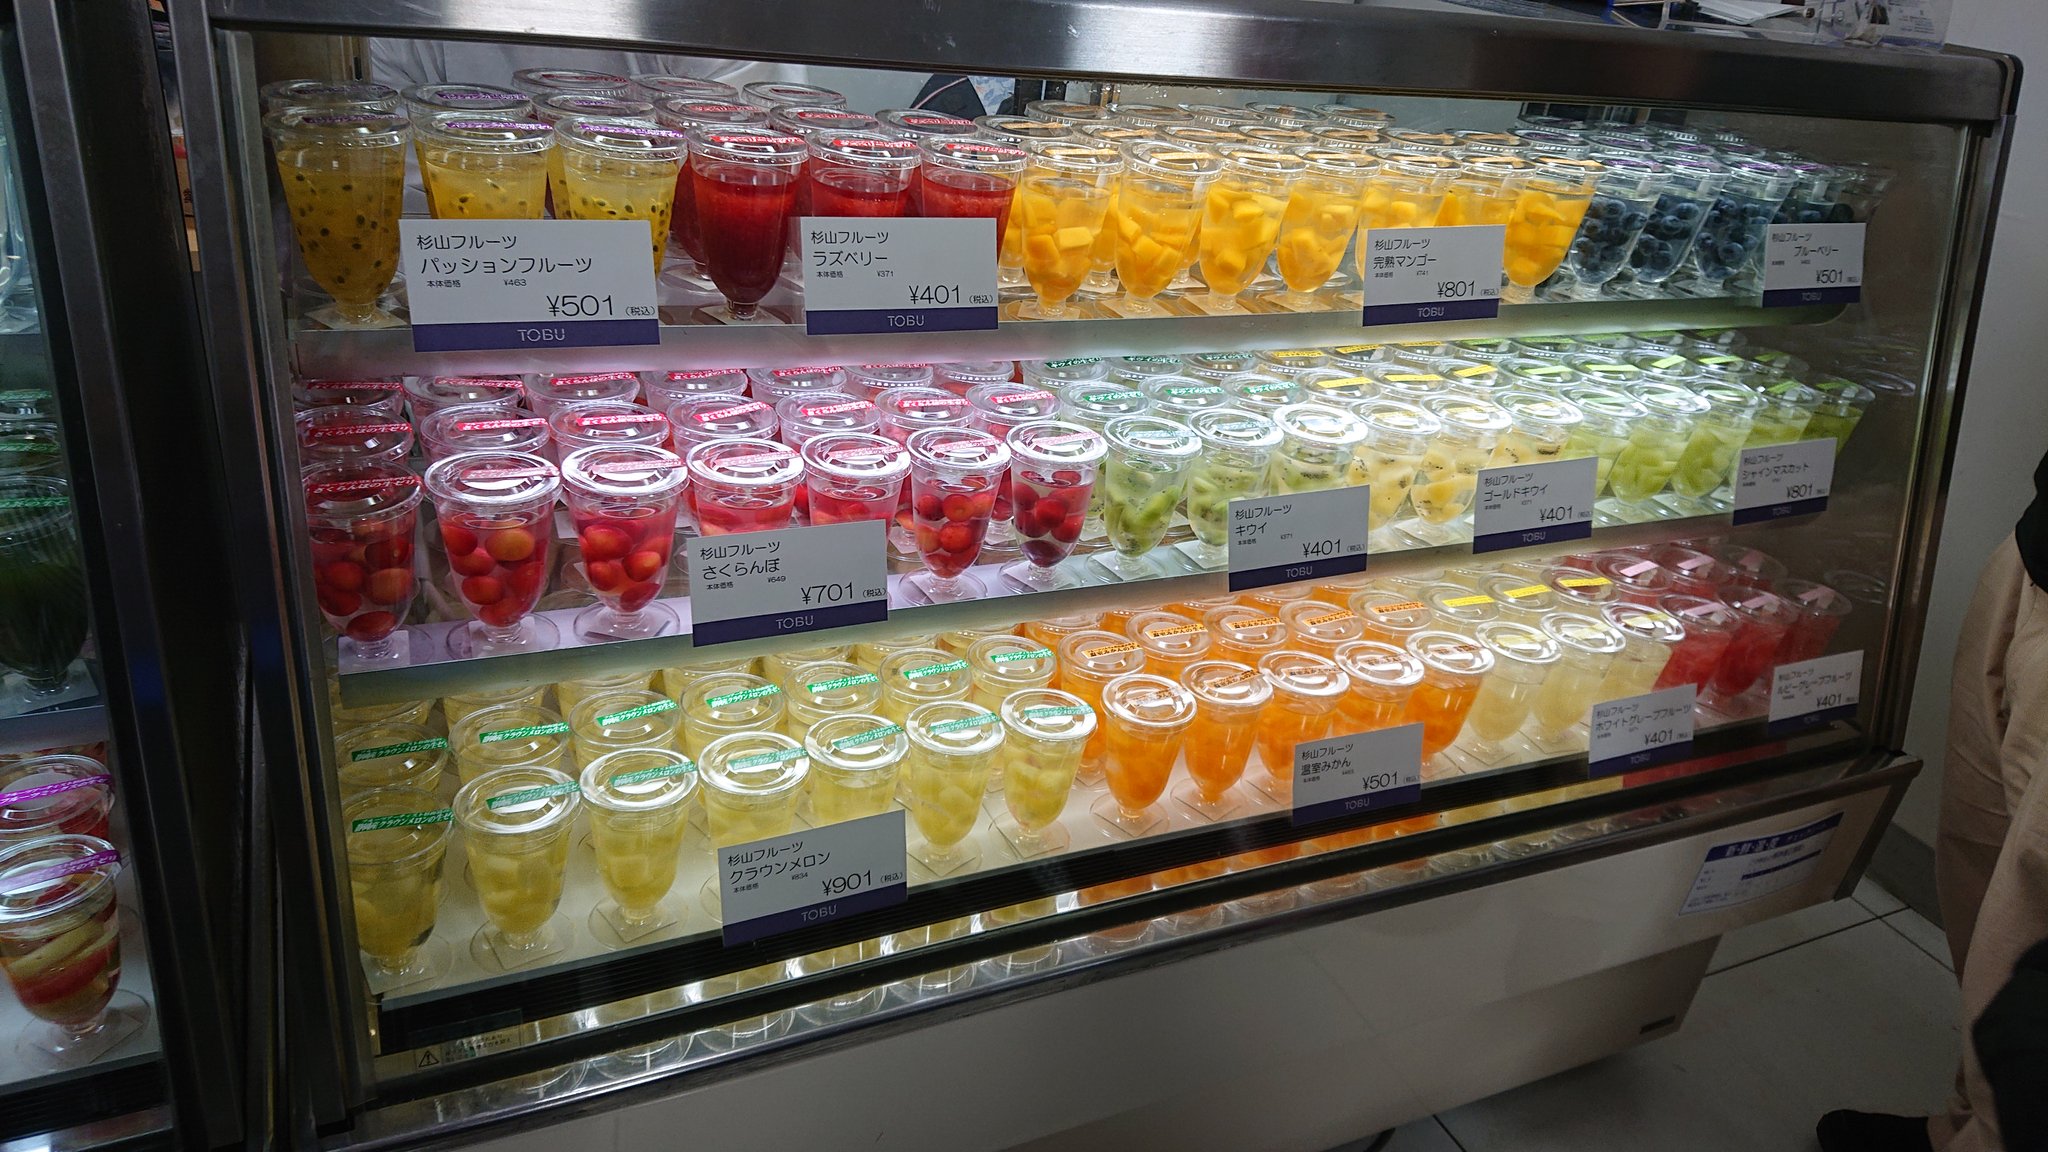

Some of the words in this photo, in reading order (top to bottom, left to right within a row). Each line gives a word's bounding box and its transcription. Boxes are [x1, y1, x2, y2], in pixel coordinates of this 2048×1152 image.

[416, 234, 518, 251] 杉山フルーツ
[811, 231, 889, 245] 杉山フルーツ
[1374, 238, 1431, 251] 杉山フルーツ
[421, 257, 592, 275] パッションフルーツ
[812, 251, 888, 267] ラズベリー
[1373, 253, 1437, 269] 完熟マンゴー
[876, 270, 894, 278] ¥371
[1816, 269, 1843, 283] ¥501
[427, 280, 461, 288] 本体価格
[503, 278, 527, 287] ¥463
[1437, 280, 1476, 298] ¥801
[908, 285, 960, 305] ¥401
[546, 295, 614, 317] ¥501
[1417, 307, 1445, 318] TOBU
[887, 314, 925, 328] TOBU
[517, 328, 565, 342] TOBU
[1484, 473, 1534, 487] 杉山フルーツ
[1483, 484, 1548, 502] ゴールドキウイ
[1787, 483, 1813, 499] ¥801
[1235, 504, 1292, 521] 杉山フルーツ
[1540, 506, 1573, 523] ¥401
[1235, 522, 1267, 537] キウイ
[1522, 532, 1546, 542] TOBU
[700, 541, 781, 561] 杉山フルーツ
[1302, 539, 1341, 558] ¥401
[703, 558, 780, 580] さくらんぼ
[1286, 566, 1313, 578] TOBU
[767, 575, 786, 583] ¥649
[801, 582, 853, 605] ¥701
[775, 615, 814, 630] TOBU
[1817, 693, 1842, 707] ¥401
[1645, 729, 1673, 745] ¥401
[1302, 743, 1354, 760] 杉山フルーツ
[1301, 757, 1351, 776] 温室みかん
[1362, 771, 1398, 791] ¥501
[1345, 798, 1370, 810] TOBU
[727, 841, 804, 867] 杉山フルーツ
[730, 852, 831, 884] クラウンメロン
[822, 870, 873, 896] ¥901
[801, 904, 838, 922] TOBU
